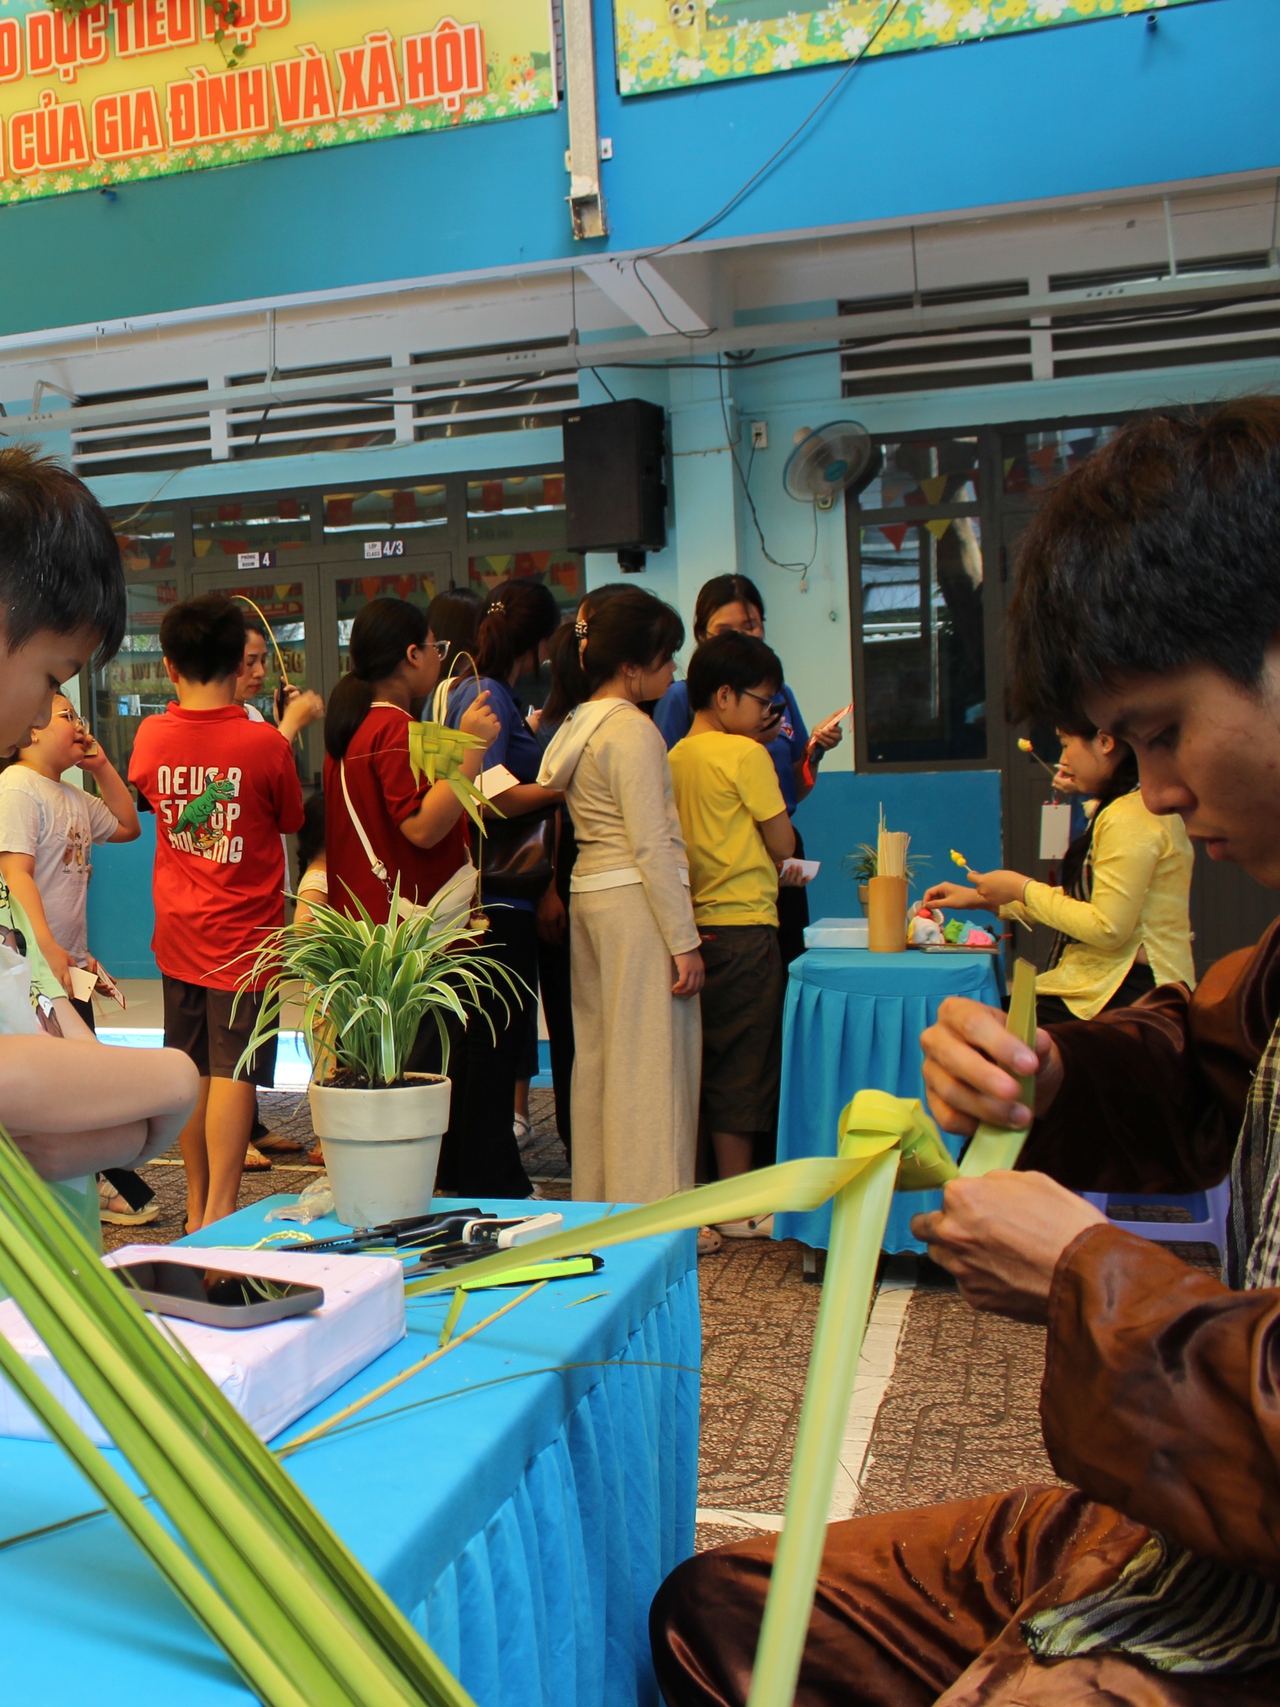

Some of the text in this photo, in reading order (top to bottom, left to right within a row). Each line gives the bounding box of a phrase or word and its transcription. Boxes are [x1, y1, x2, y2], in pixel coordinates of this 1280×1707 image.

[26, 3, 107, 82] DỤC
[9, 89, 89, 174] CỦA
[92, 86, 163, 159] GIA
[166, 64, 270, 147] ĐÌNH
[271, 42, 336, 127] VÀ
[334, 28, 401, 117] XÃ
[402, 15, 484, 113] HỘI
[262, 552, 270, 567] 4
[383, 540, 404, 556] 4/3
[160, 799, 241, 832] STOP
